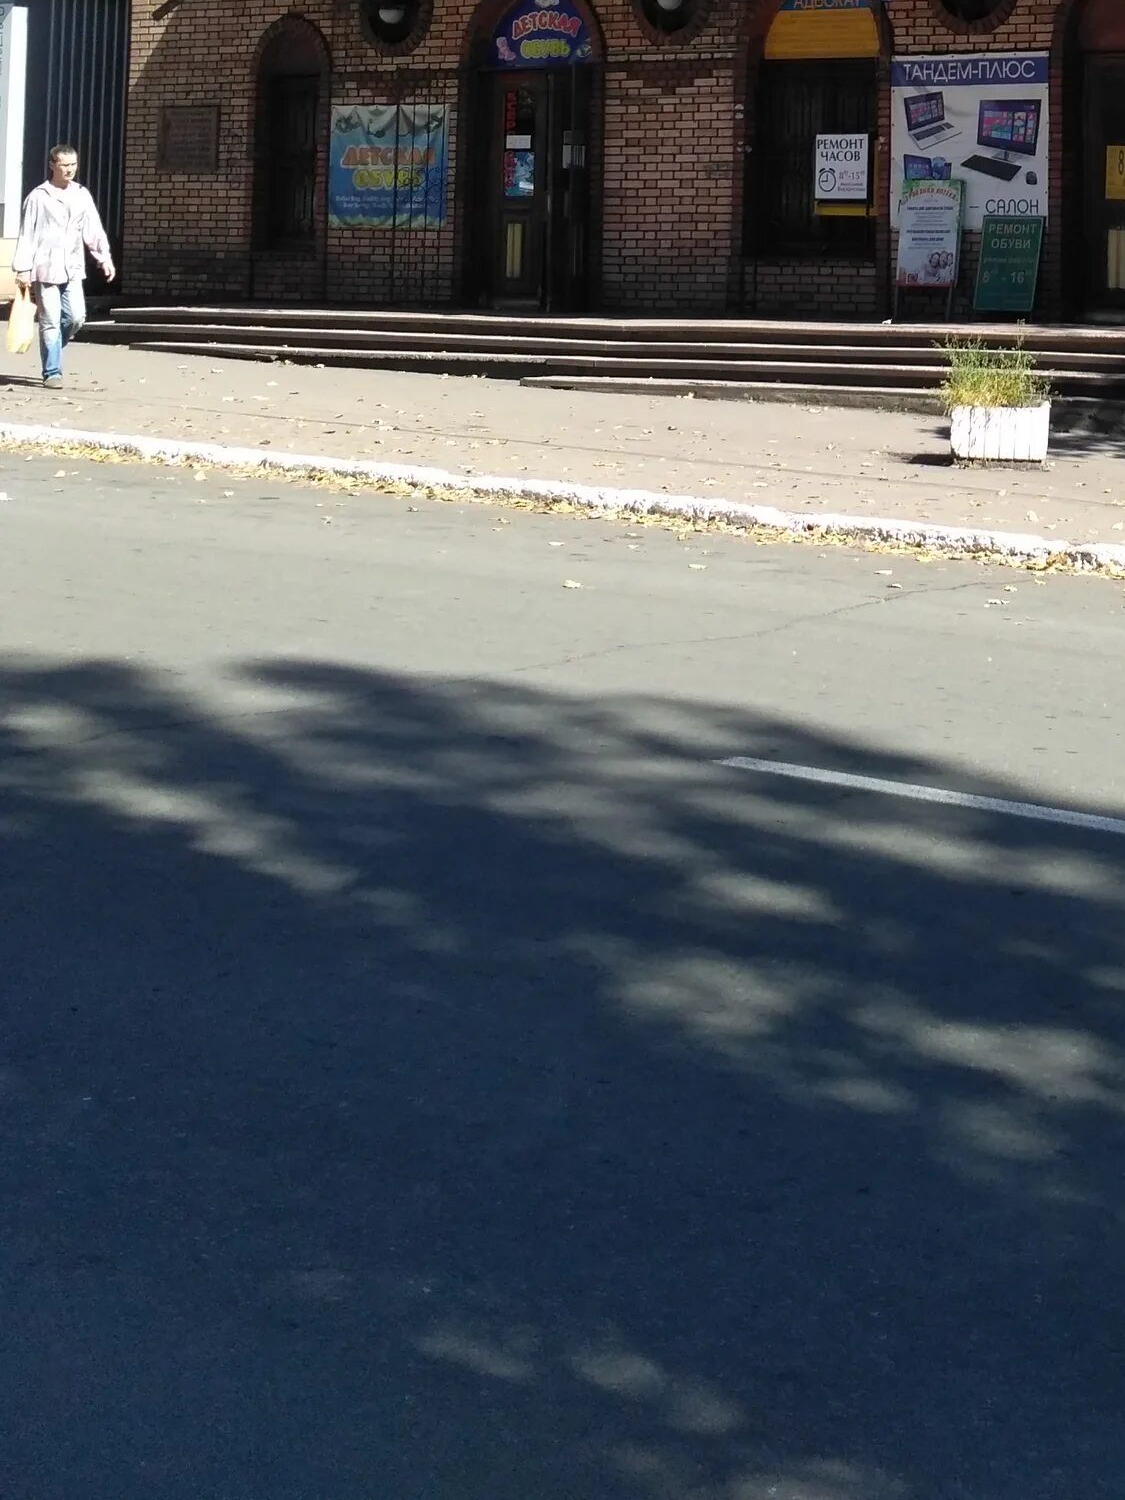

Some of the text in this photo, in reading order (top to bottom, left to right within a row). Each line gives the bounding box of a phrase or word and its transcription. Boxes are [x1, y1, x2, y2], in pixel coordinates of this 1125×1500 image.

[512, 10, 582, 40] ДЕТСКАЯ
[520, 39, 571, 59] ОБУВЬ
[904, 60, 1036, 83] ТАНДЕМ-ПЛЮС
[817, 139, 864, 150] РЕМОНТ
[821, 150, 861, 162] ЧАСОВ
[985, 199, 1039, 214] САЛОН
[989, 224, 1037, 235] РЕМОНТ
[991, 238, 1031, 249] ОБУВИ
